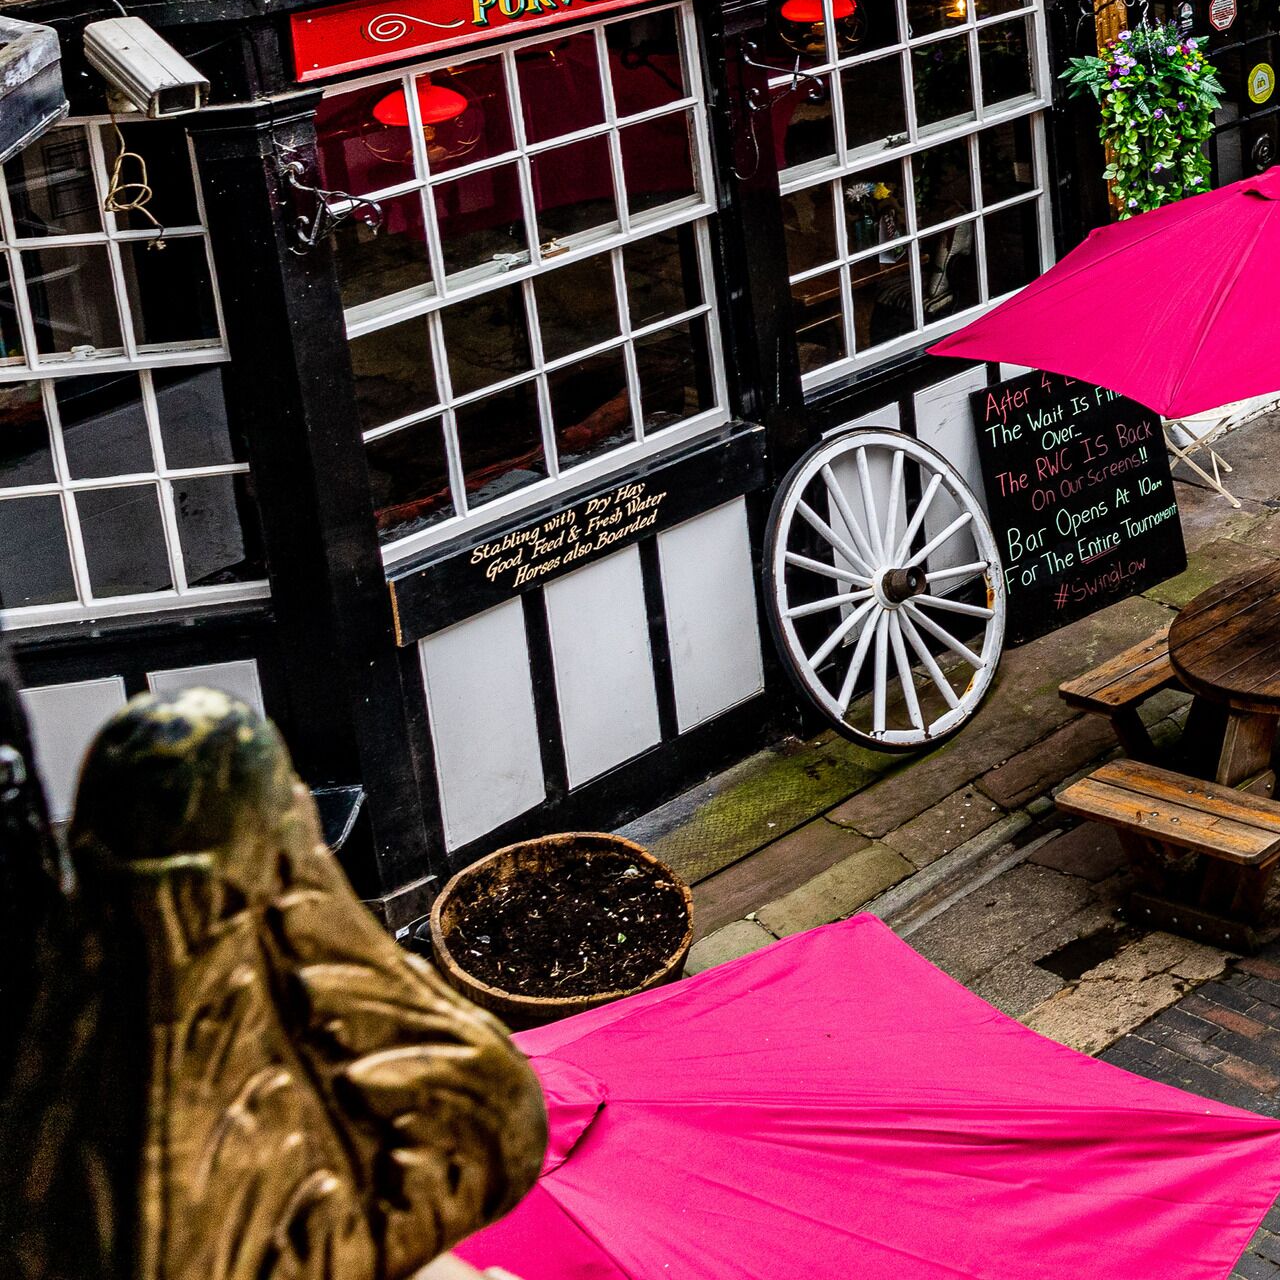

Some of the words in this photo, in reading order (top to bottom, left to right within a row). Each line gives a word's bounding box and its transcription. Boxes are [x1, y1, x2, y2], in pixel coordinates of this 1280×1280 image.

[985, 387, 1031, 424] After
[985, 424, 1022, 448] The
[1027, 404, 1063, 431] Wait
[995, 472, 1029, 497] The
[1035, 448, 1073, 481] RWC
[1116, 421, 1153, 448] Back
[1032, 490, 1056, 511] On
[1060, 476, 1084, 498] Our
[470, 527, 540, 564] Stabling
[544, 510, 576, 533] with
[585, 496, 611, 516] Dry
[613, 482, 645, 502] Hay
[486, 551, 523, 582] Good
[531, 533, 564, 560] Feed
[567, 526, 582, 542] &
[584, 508, 623, 536] Fresh
[626, 491, 667, 517] Water
[512, 555, 560, 588] Horses
[563, 541, 593, 563] also
[593, 509, 658, 551] Boarded
[1004, 565, 1039, 594] For
[1040, 551, 1074, 575] The
[1078, 531, 1121, 561] Entire
[1120, 502, 1177, 539] Tournament
[1007, 527, 1047, 561] Bar
[1056, 501, 1108, 537] Opens
[1116, 488, 1130, 508] At
